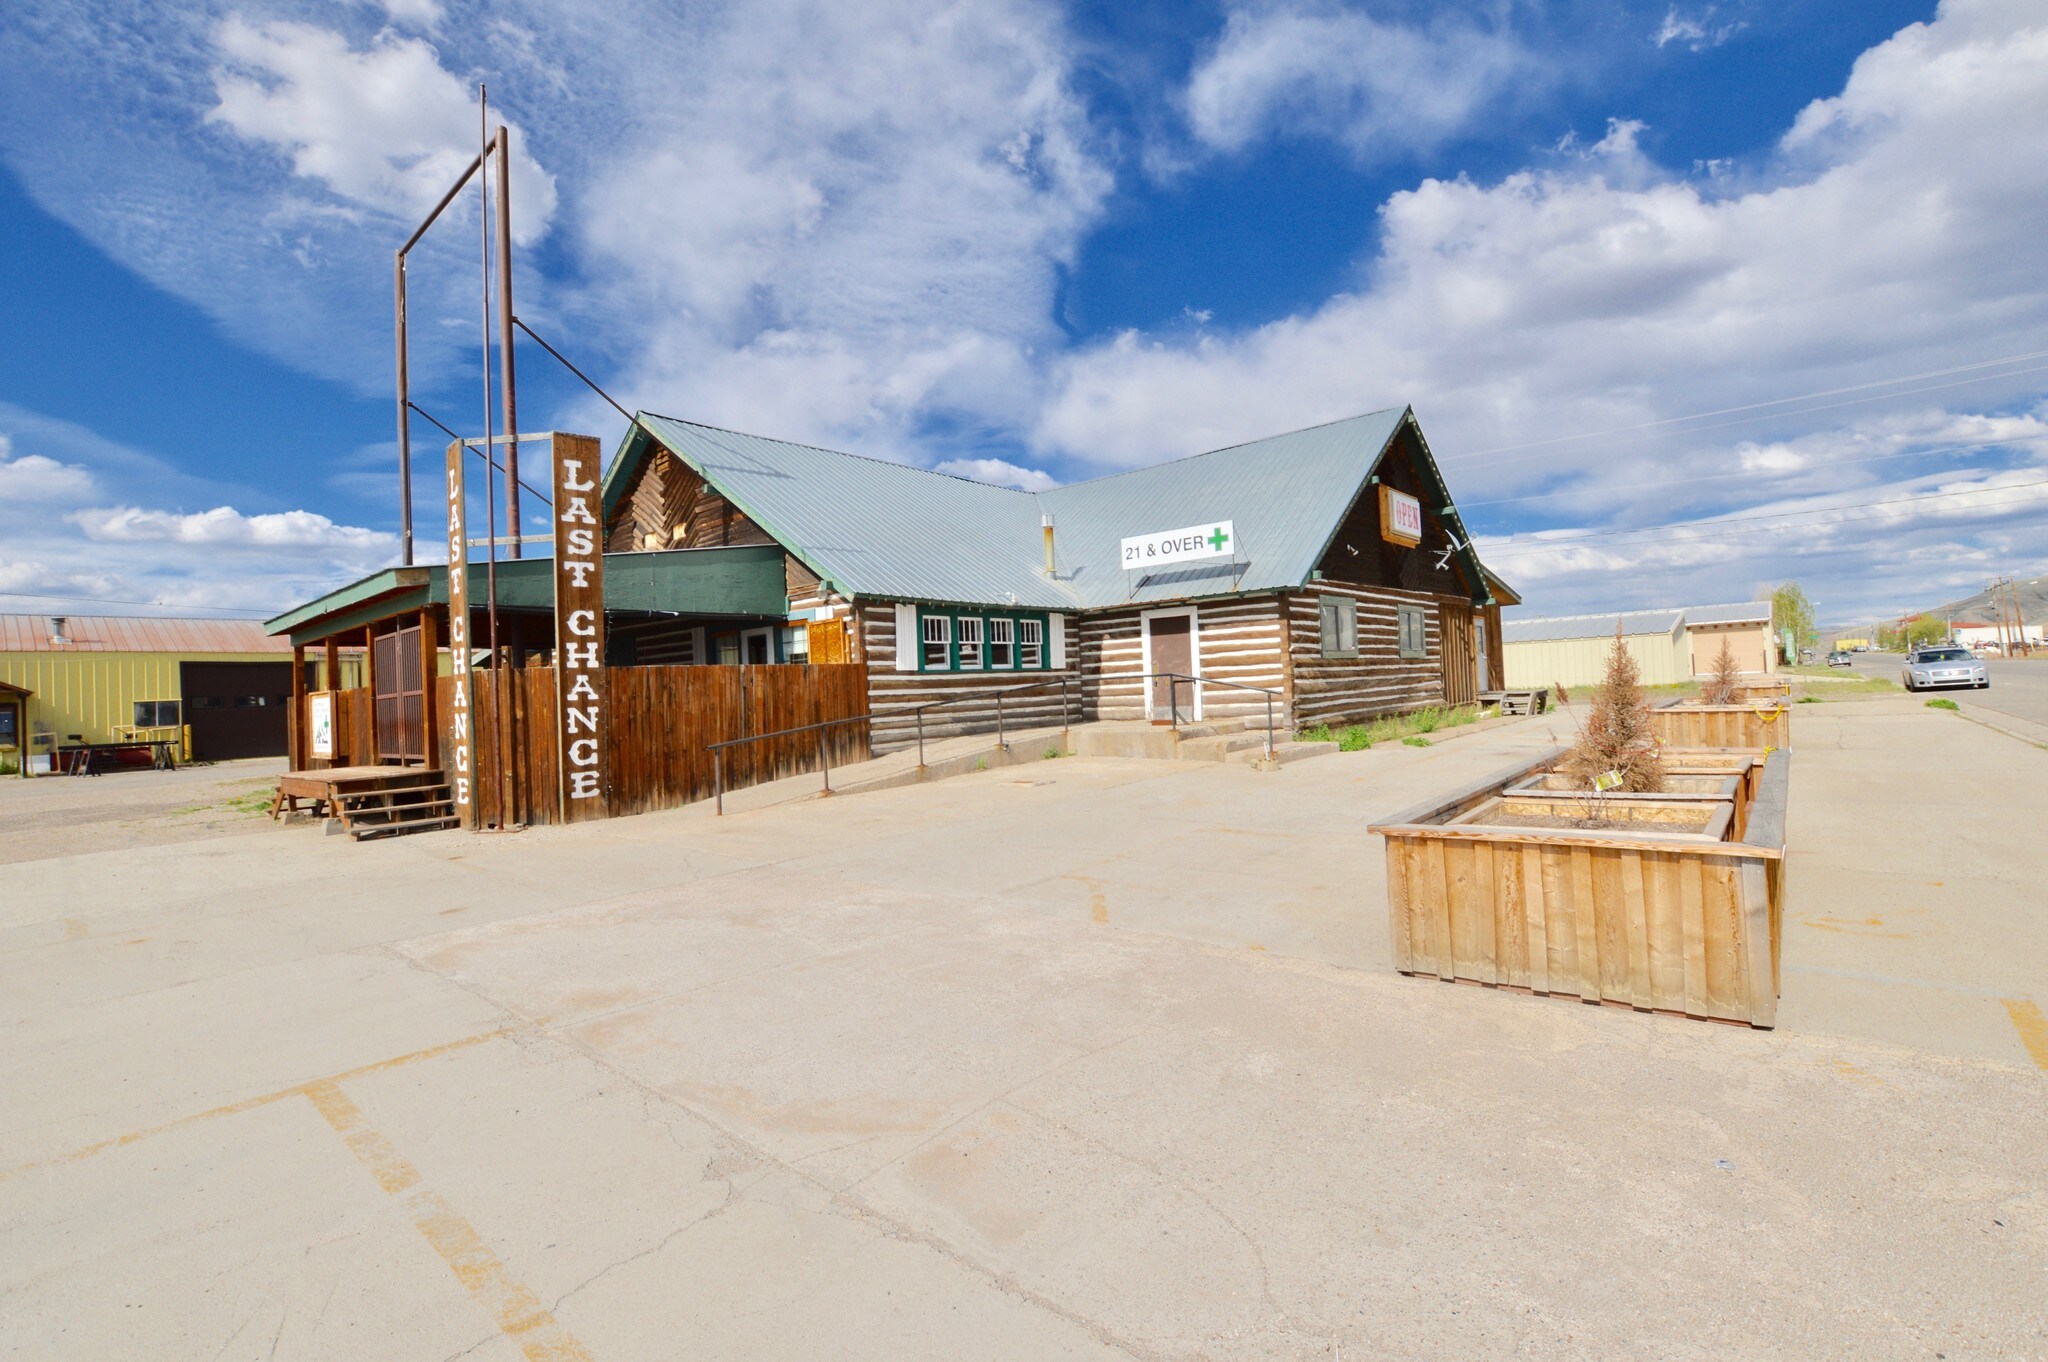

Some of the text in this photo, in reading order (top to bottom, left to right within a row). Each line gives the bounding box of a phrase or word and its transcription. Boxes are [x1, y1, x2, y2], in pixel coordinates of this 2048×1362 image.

[1126, 535, 1204, 560] 21 & OVER
[1396, 500, 1419, 530] OPEN
[449, 469, 469, 804] LAST CHANCE
[561, 459, 600, 799] LAST CHANCE
